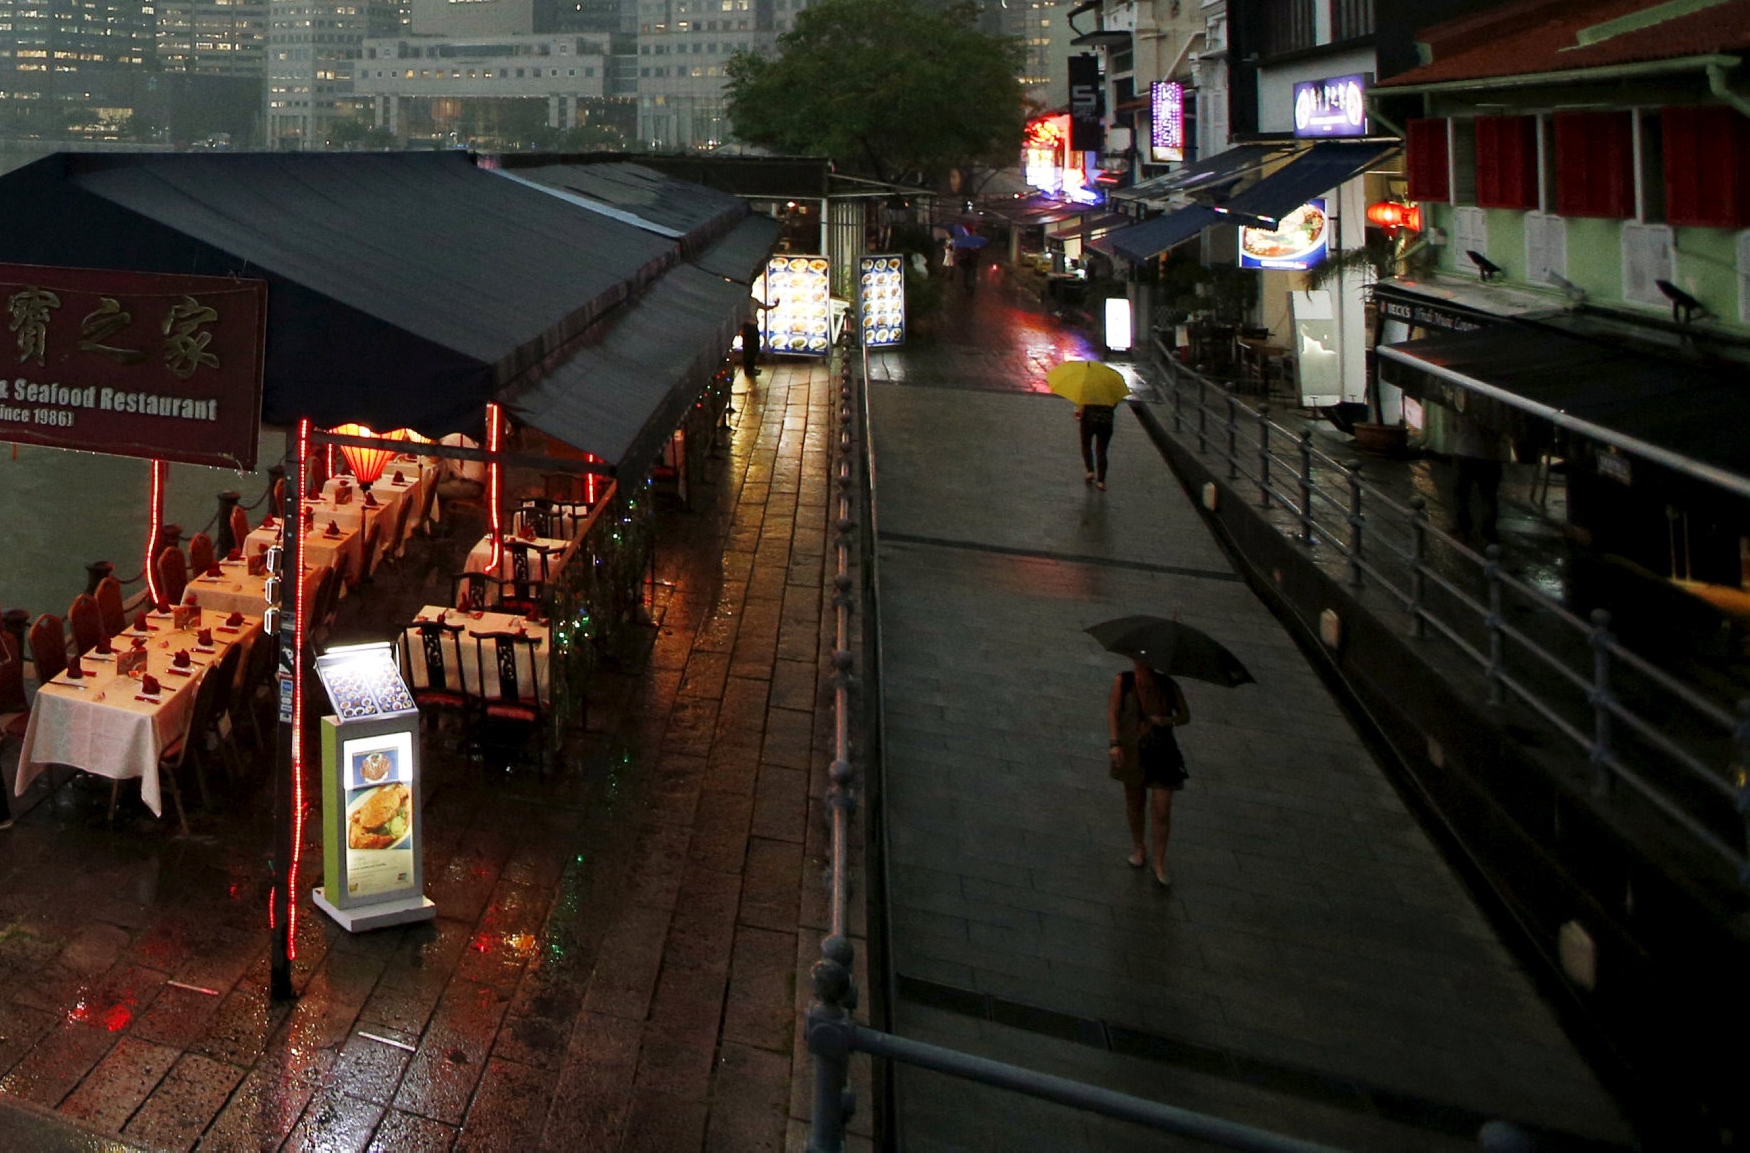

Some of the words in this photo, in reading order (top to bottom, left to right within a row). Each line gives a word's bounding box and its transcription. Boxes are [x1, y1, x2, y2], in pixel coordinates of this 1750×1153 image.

[14, 378, 96, 408] Seafood
[100, 387, 218, 421] Restaurant
[33, 408, 75, 427] 1986)
